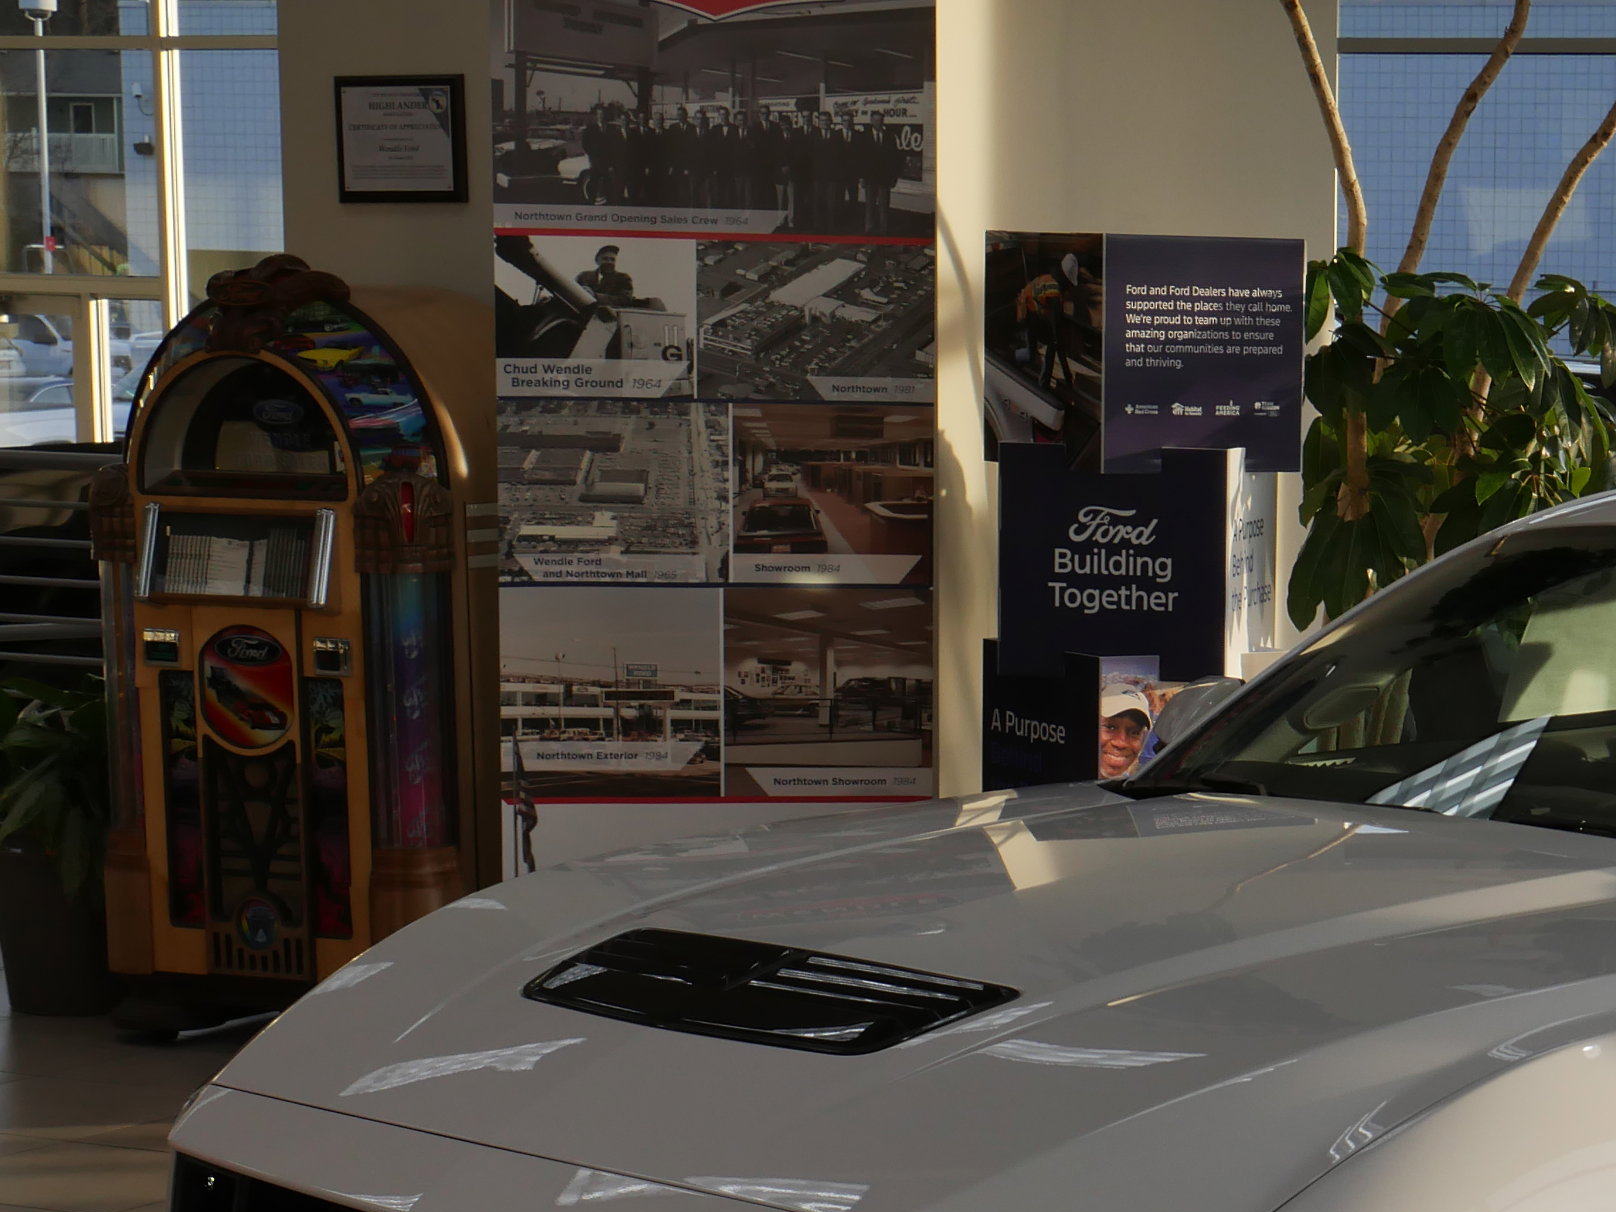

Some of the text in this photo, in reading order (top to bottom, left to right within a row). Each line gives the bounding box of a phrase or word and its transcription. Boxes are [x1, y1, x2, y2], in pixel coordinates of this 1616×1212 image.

[514, 211, 572, 222] Northtown
[575, 212, 608, 223] Grand
[611, 213, 657, 225] Opening
[660, 214, 688, 224] Sales
[691, 215, 718, 225] Crew
[1126, 284, 1283, 299] Ford and Ford Dealers have always
[1126, 300, 1293, 313] supported the places they call home.
[1126, 314, 1281, 327] We're proud to team up with these
[1125, 328, 1275, 341] amazing organizations to ensure
[1125, 342, 1284, 356] that our communities are prepared
[503, 364, 593, 375] Chud Wendle
[1125, 357, 1184, 370] and thriving.
[511, 377, 662, 390] Breaking Ground 1964
[832, 384, 888, 394] Northtown
[1068, 505, 1159, 546] Ford
[533, 557, 602, 566] Wendle Ford
[754, 563, 841, 573] Showroom 1984
[1053, 548, 1173, 583] Building
[543, 570, 563, 579] and
[565, 570, 623, 579] Northtown
[626, 570, 648, 579] Mall
[1048, 581, 1179, 614] Together
[227, 637, 269, 660] Ford
[991, 708, 1066, 745] A Purpose
[536, 751, 593, 760] Northtown
[596, 751, 638, 760] Exterior
[773, 777, 829, 786] Northtown
[831, 777, 887, 786] Showroom
